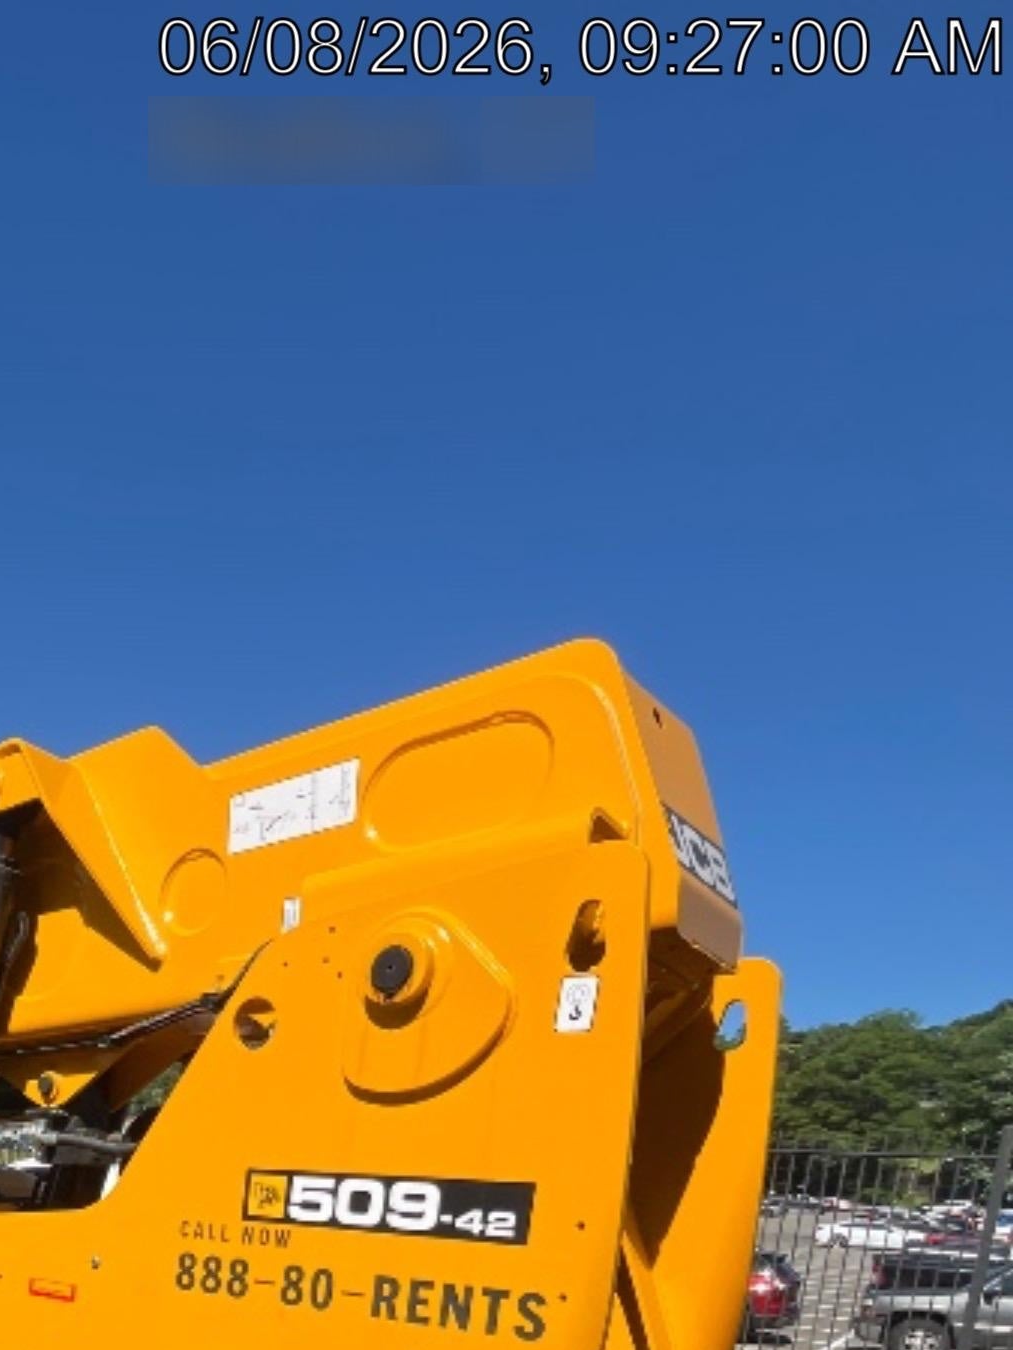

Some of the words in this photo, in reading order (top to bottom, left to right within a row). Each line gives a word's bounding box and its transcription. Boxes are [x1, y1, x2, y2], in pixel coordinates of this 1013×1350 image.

[670, 813, 736, 902] JCB
[179, 1220, 230, 1244] CALL
[241, 1226, 290, 1249] NOW
[287, 1174, 517, 1238] 509-42
[175, 1251, 547, 1342] 888-80-RENTS
